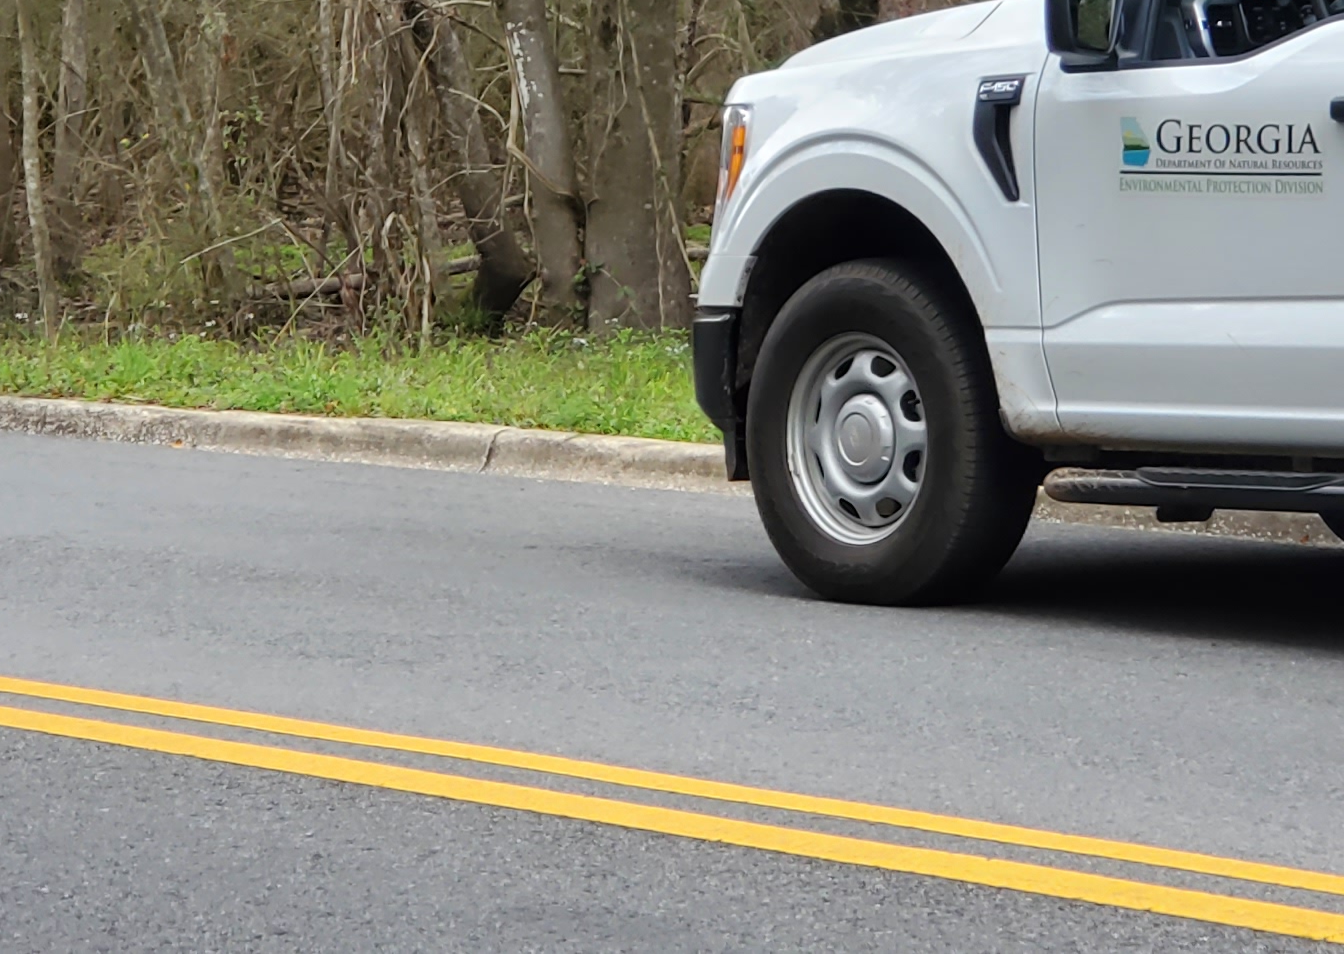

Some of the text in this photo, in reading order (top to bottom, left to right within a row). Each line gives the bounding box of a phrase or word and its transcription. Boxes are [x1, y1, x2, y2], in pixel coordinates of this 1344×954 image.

[1156, 119, 1322, 155] GEORGIA
[1156, 158, 1212, 169] DEPARTMENT
[1229, 159, 1269, 169] NATURAL
[1271, 159, 1323, 169] RESOURCES
[1119, 177, 1323, 194] ENVIRONMENTAL PROTECTION DIVISION
